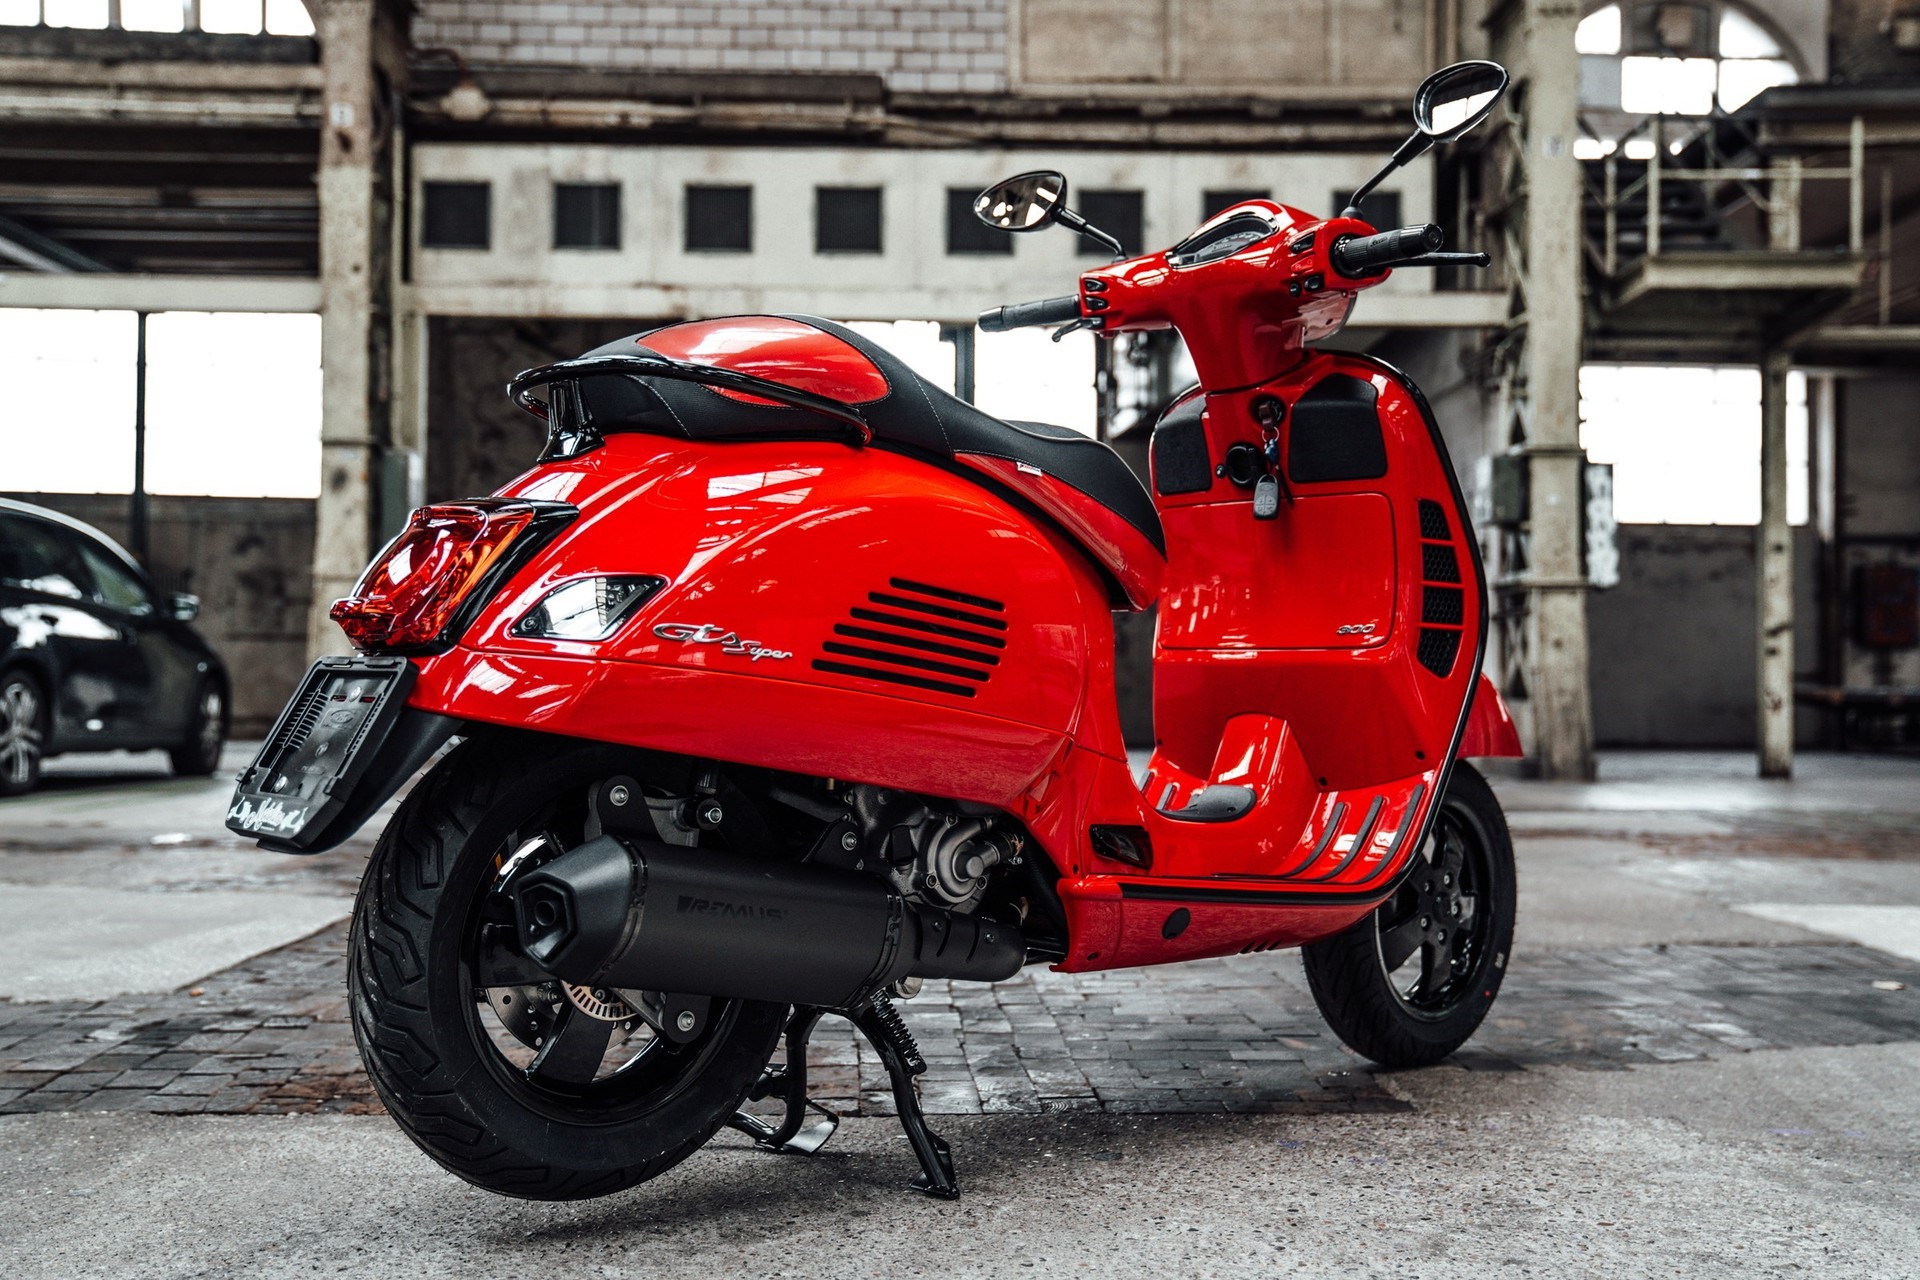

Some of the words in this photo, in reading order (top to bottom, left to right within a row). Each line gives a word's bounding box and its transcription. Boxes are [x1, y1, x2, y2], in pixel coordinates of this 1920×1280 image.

[1336, 623, 1376, 634] 300
[722, 640, 793, 661] Super
[687, 897, 782, 920] REMUS
